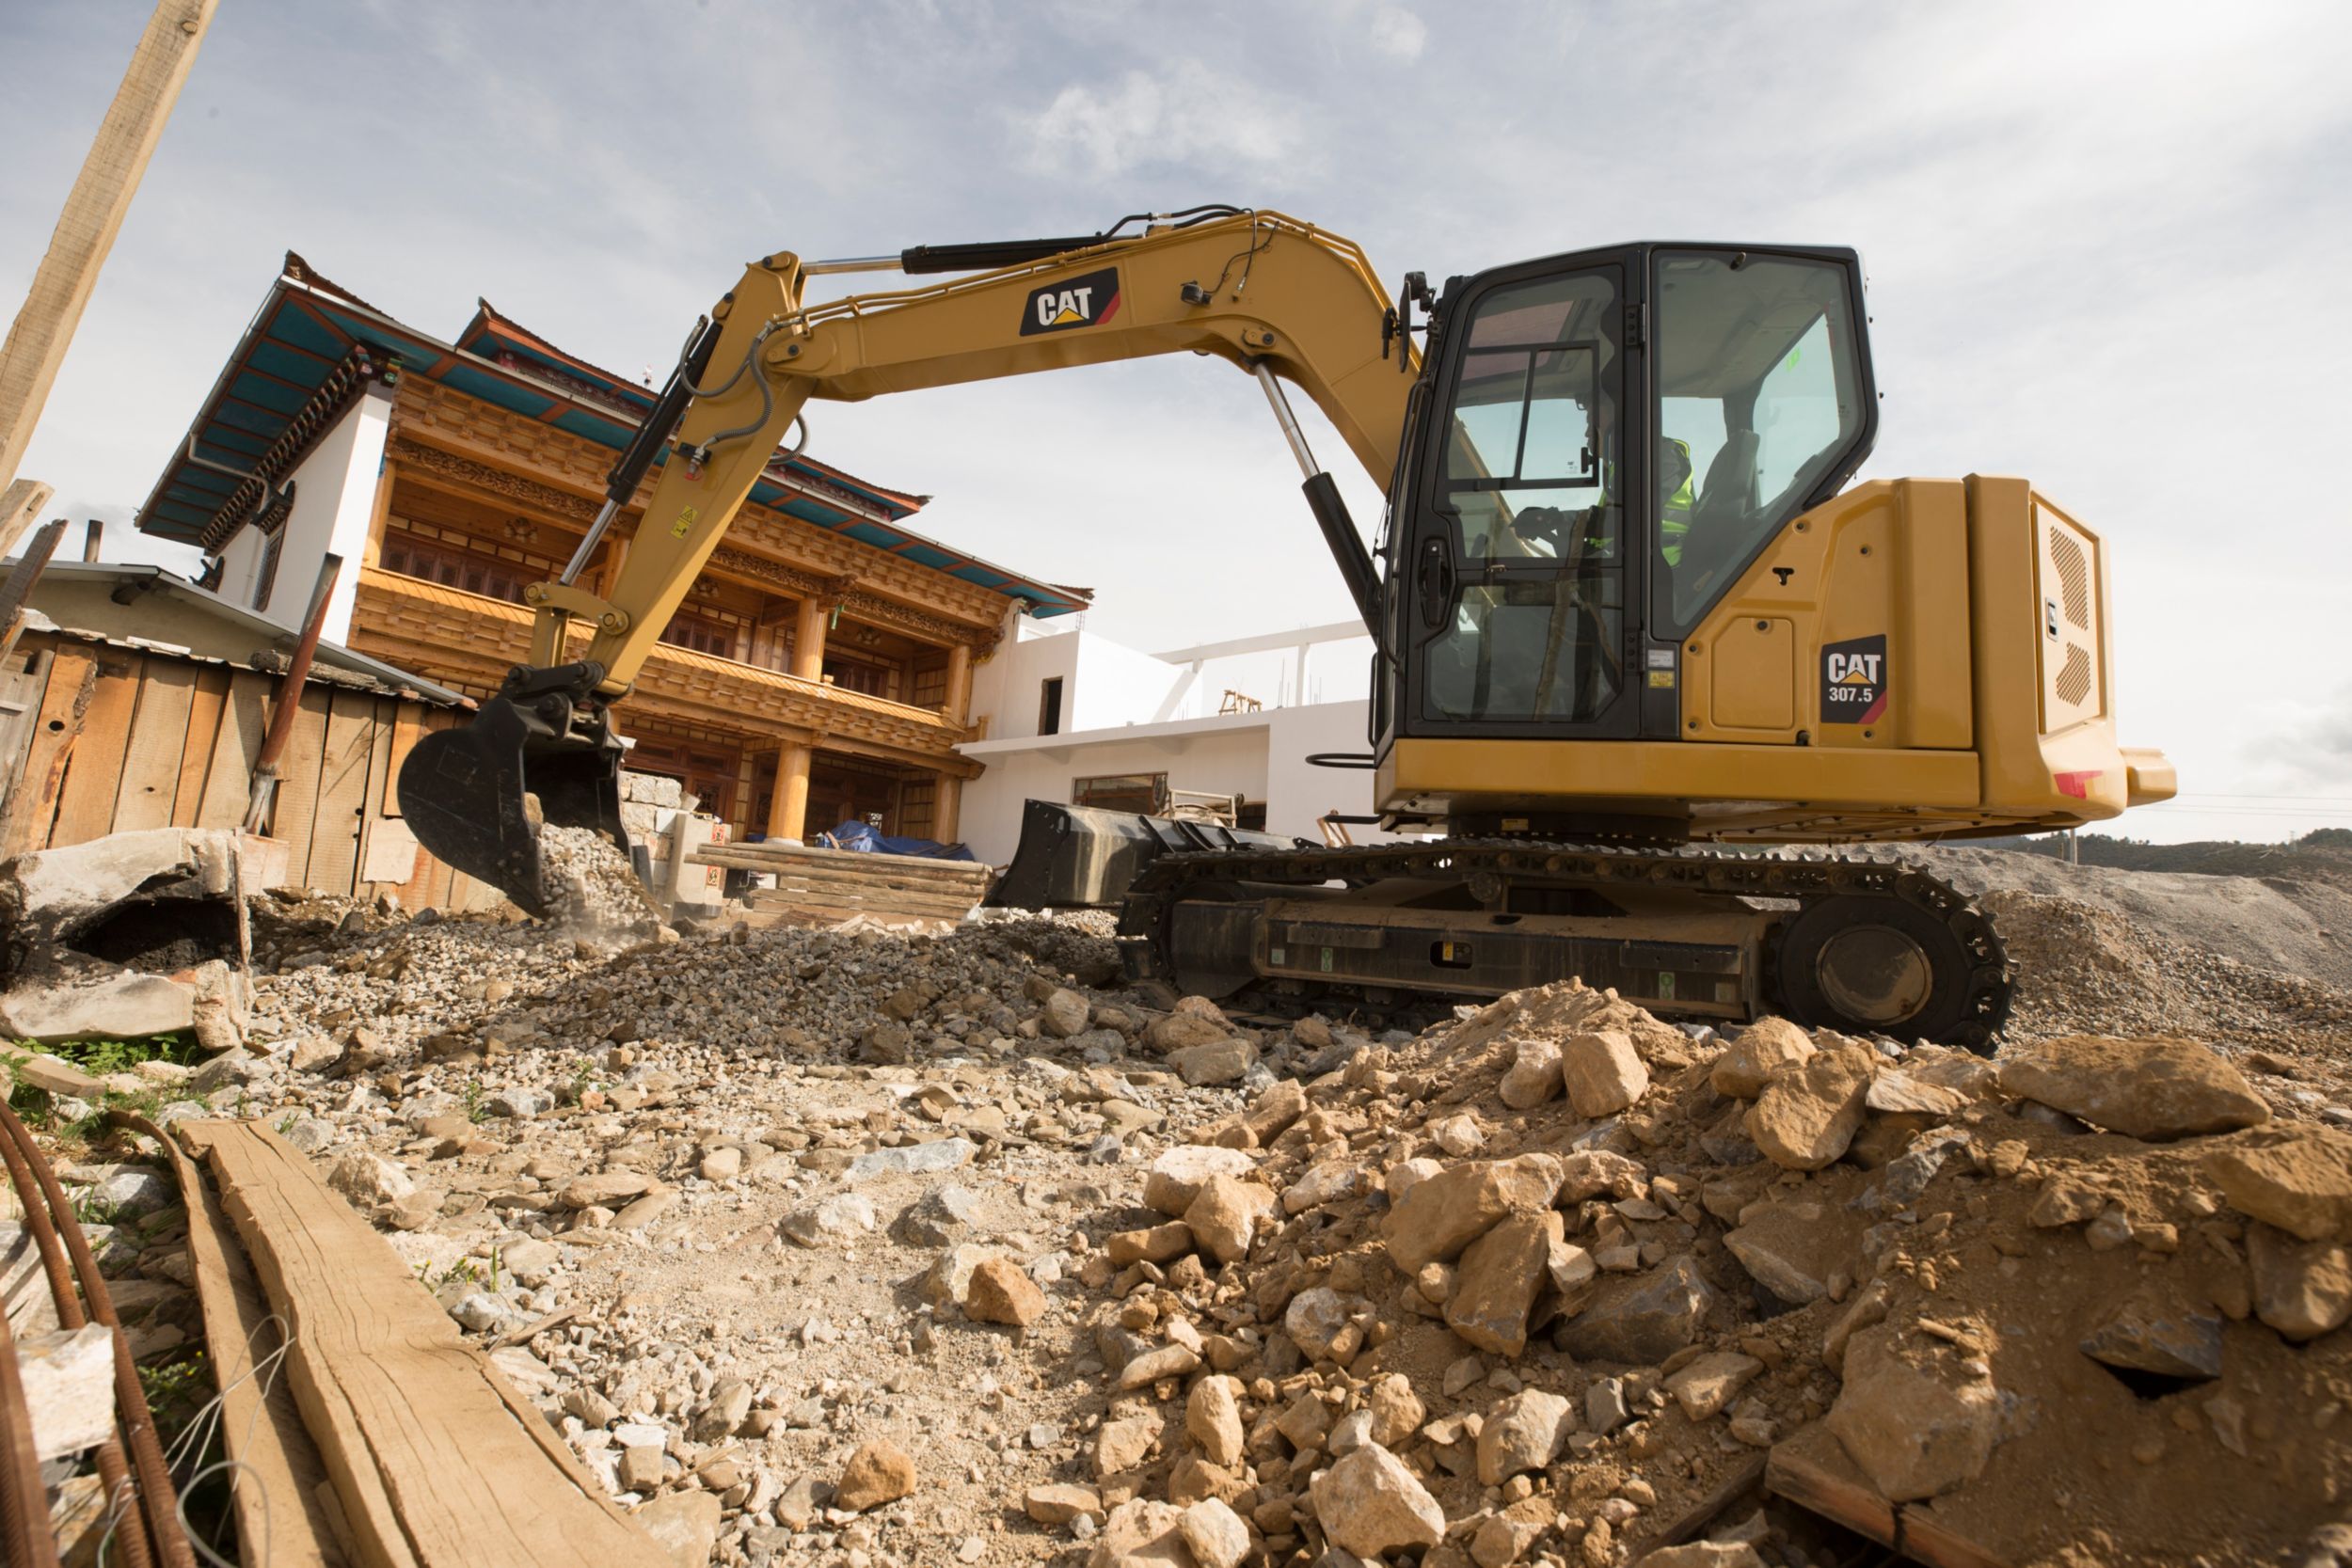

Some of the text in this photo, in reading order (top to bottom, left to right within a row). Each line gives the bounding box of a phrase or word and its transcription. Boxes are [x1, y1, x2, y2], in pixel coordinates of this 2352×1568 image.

[1037, 287, 1092, 326] CAT
[1828, 653, 1882, 685] CAT
[1829, 687, 1873, 703] 307.5
